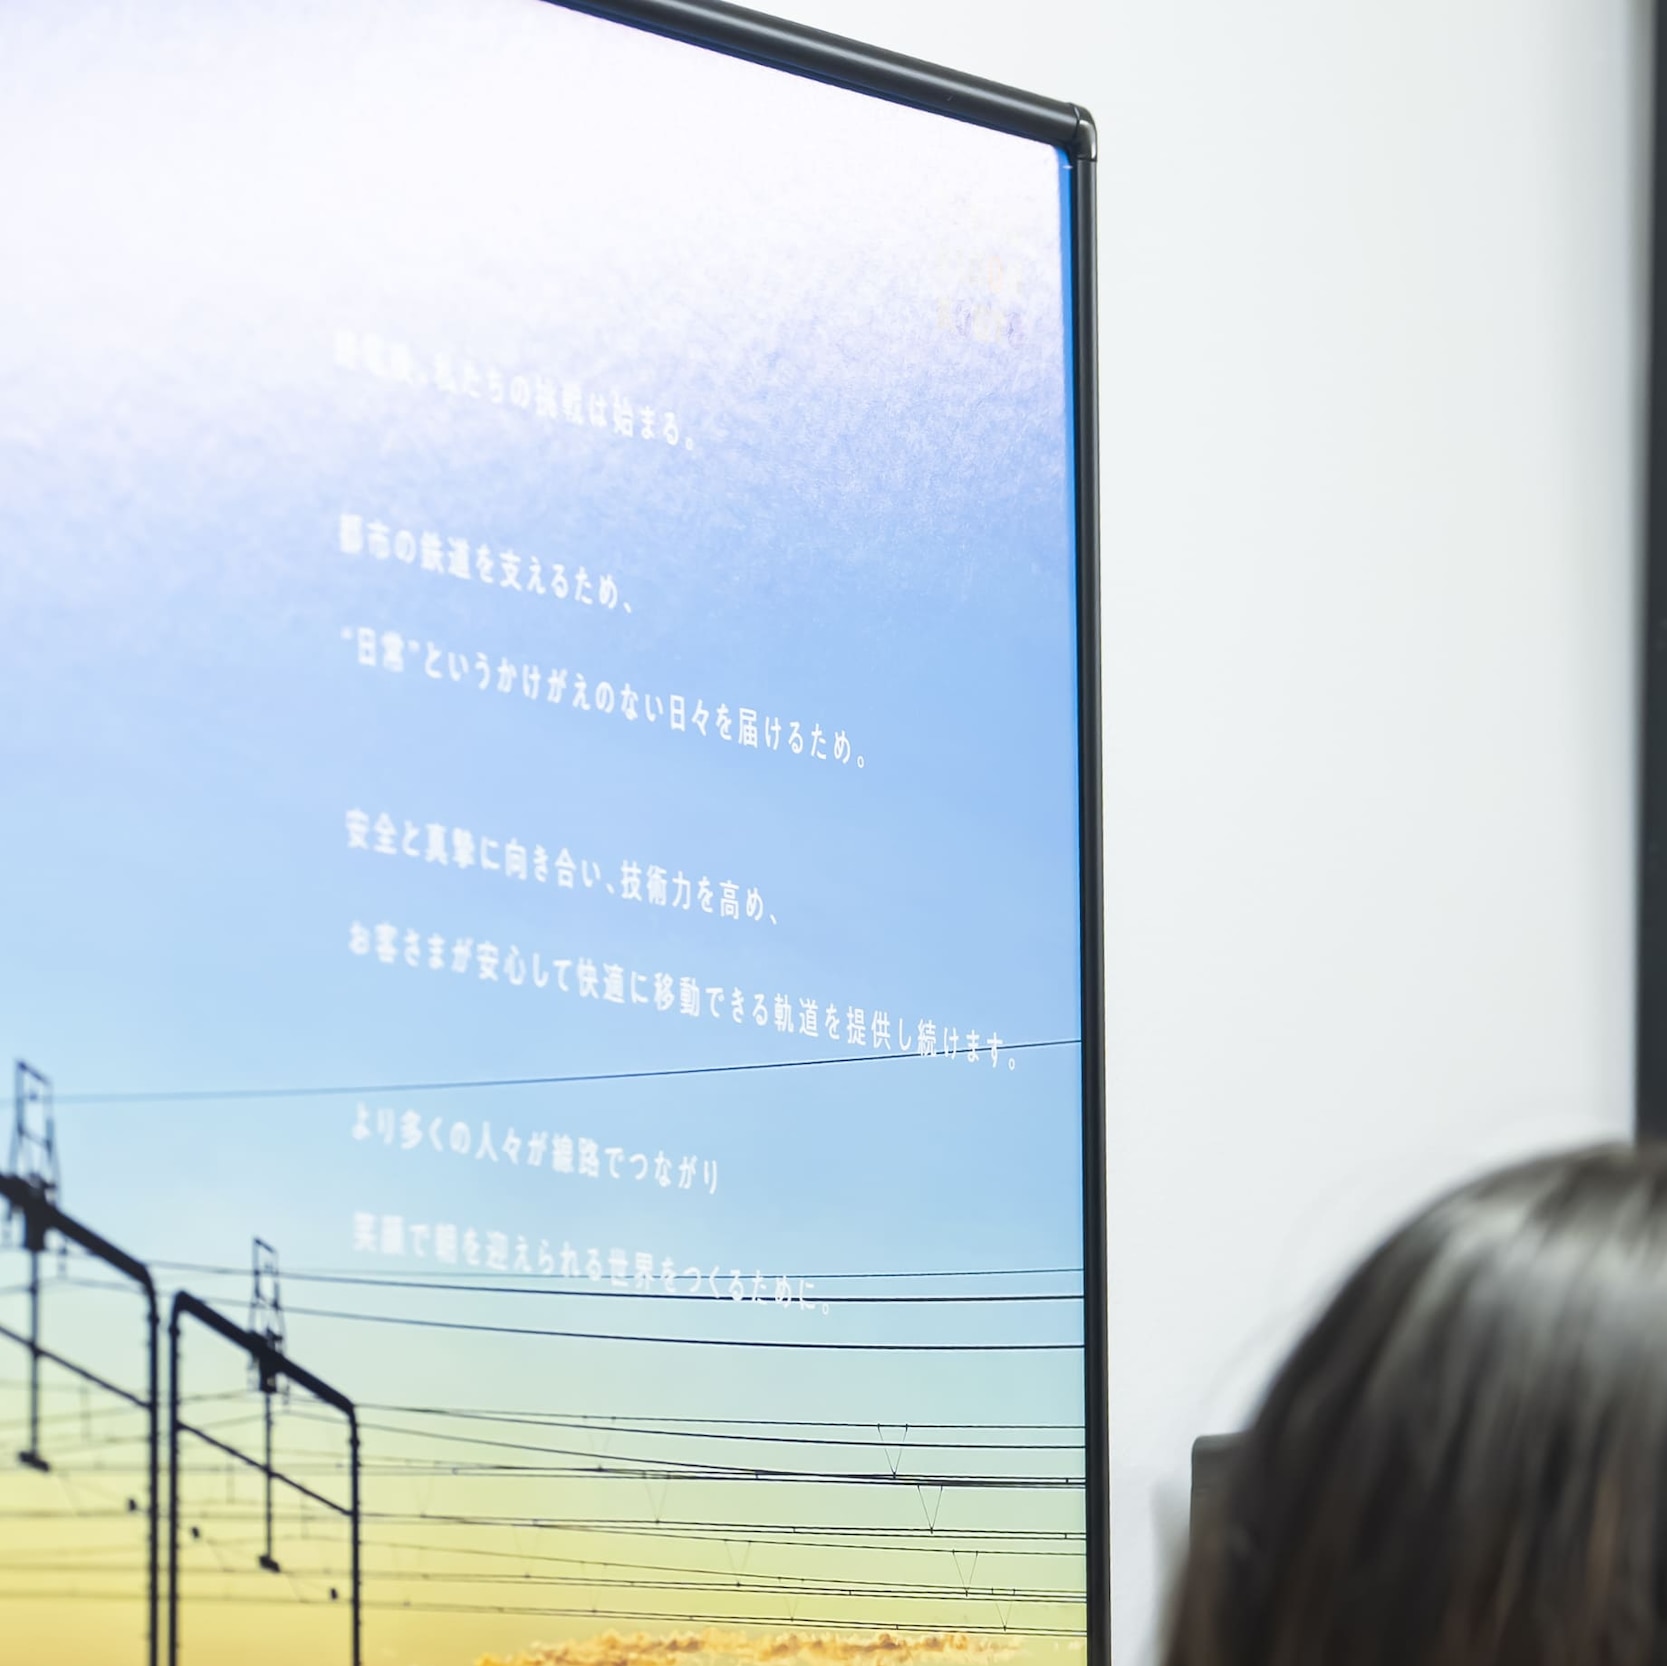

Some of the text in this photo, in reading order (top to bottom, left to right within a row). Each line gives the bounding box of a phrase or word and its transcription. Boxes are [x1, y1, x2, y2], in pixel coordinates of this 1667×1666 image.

[338, 513, 633, 615] 都市の鉄道を支えるため、
